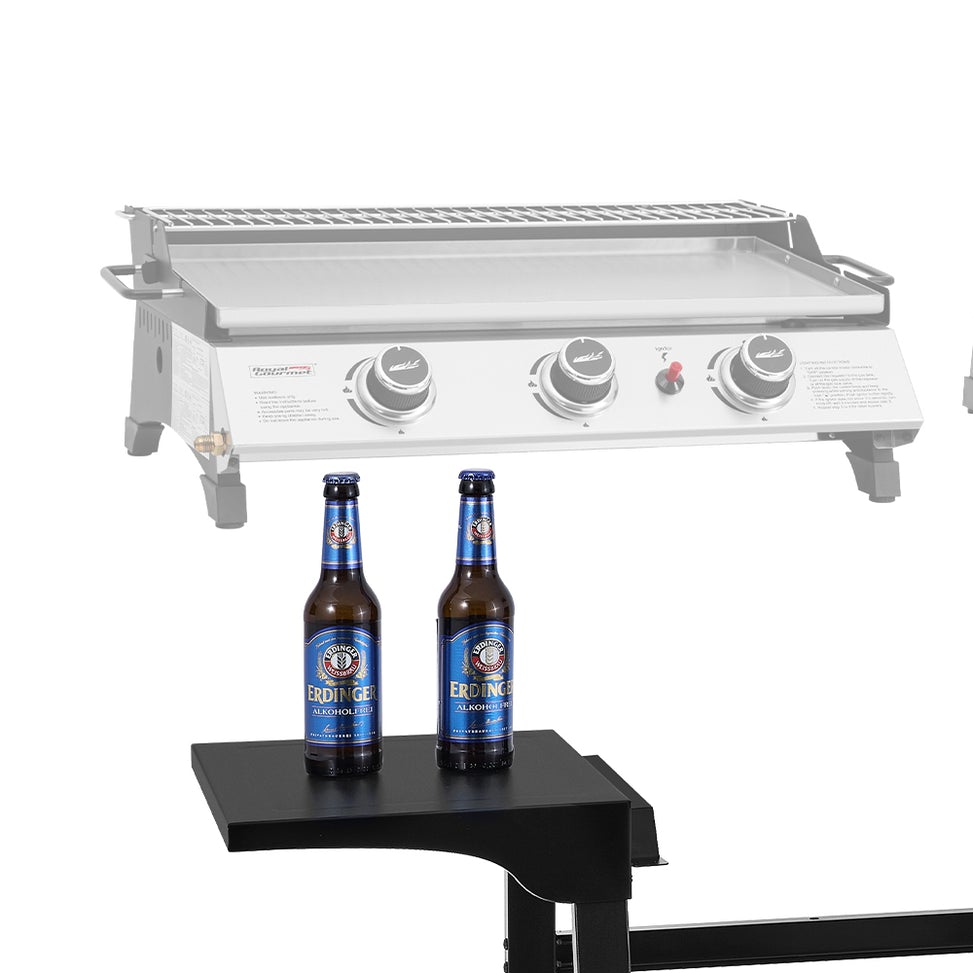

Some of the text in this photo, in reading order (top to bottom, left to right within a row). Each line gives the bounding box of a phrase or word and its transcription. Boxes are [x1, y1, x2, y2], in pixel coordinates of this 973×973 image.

[326, 645, 357, 659] ERDINGER
[473, 640, 504, 654] ERDINGER
[307, 684, 378, 704] ERDINGER
[449, 680, 513, 700] ERDINGE
[312, 706, 374, 715] ALKOHOLFREI
